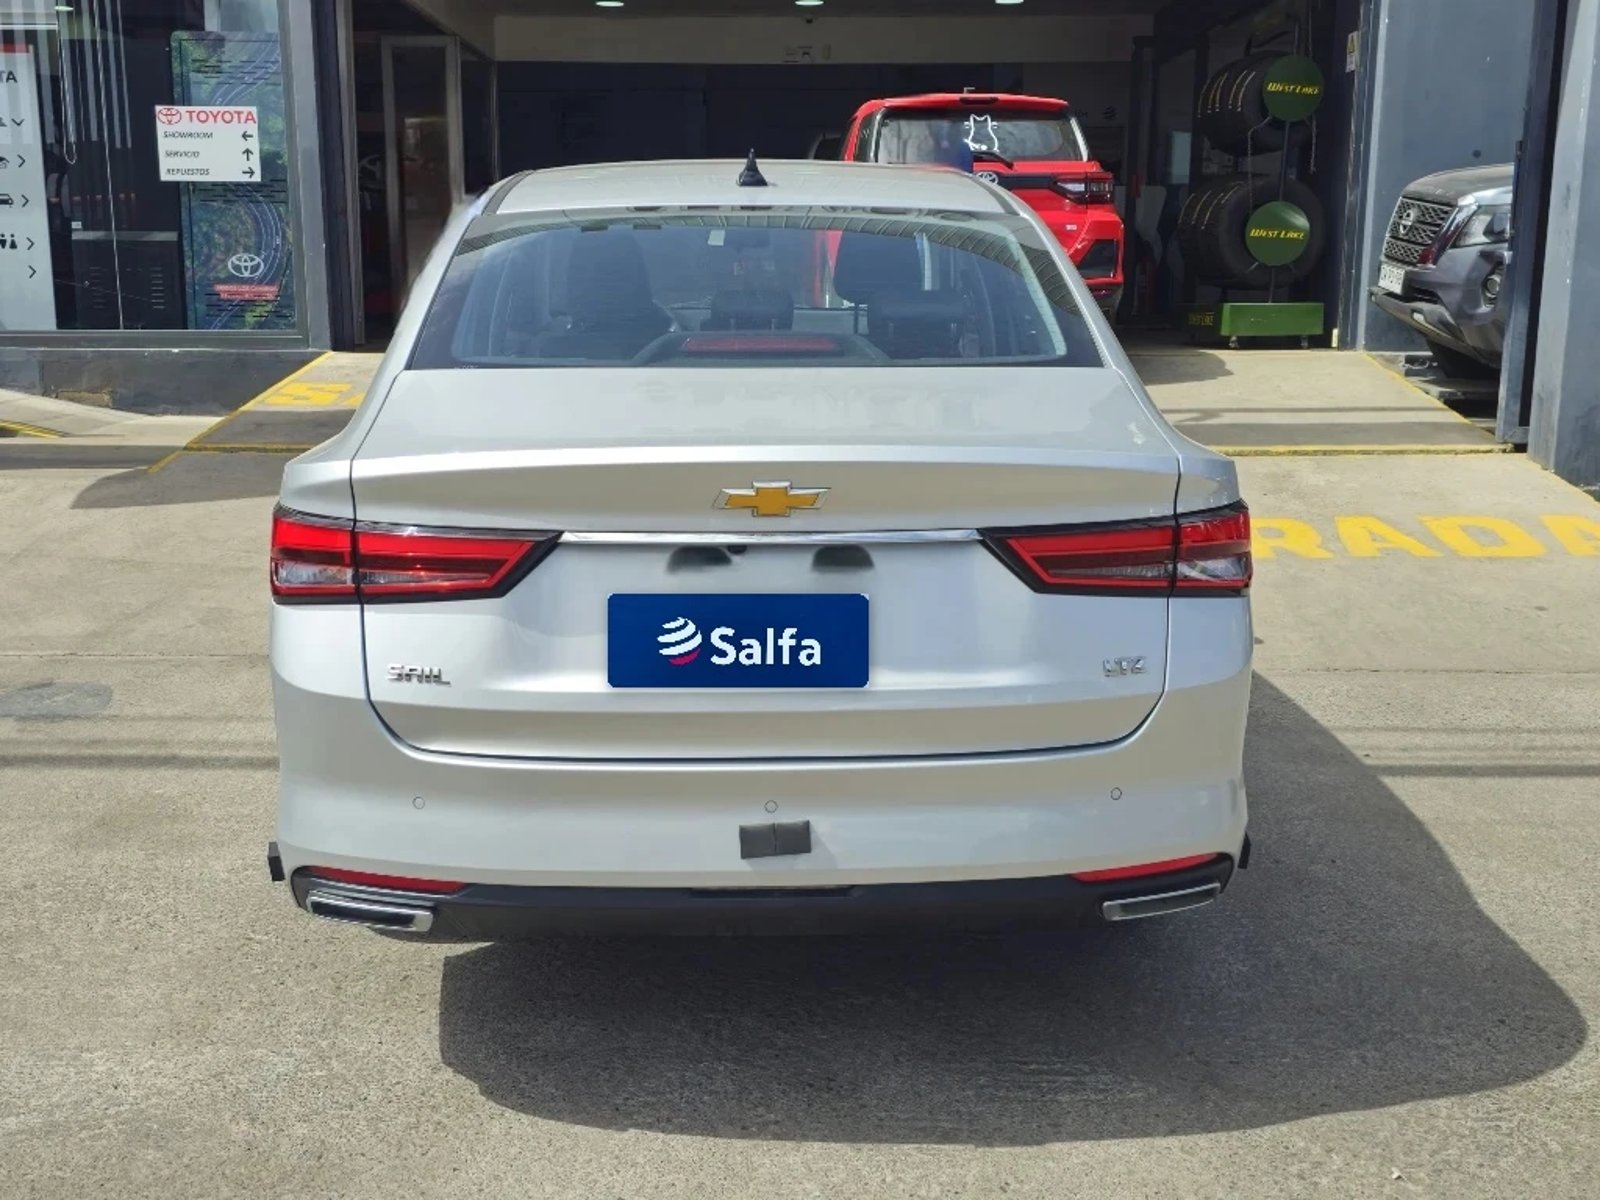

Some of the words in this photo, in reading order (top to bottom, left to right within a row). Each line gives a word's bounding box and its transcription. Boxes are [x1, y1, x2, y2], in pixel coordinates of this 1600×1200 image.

[185, 110, 257, 124] TOYOTA
[163, 131, 213, 139] SHOWROOM
[165, 150, 200, 158] SERVICIO
[166, 168, 210, 176] REPUESTOS
[386, 663, 452, 687] SAIL
